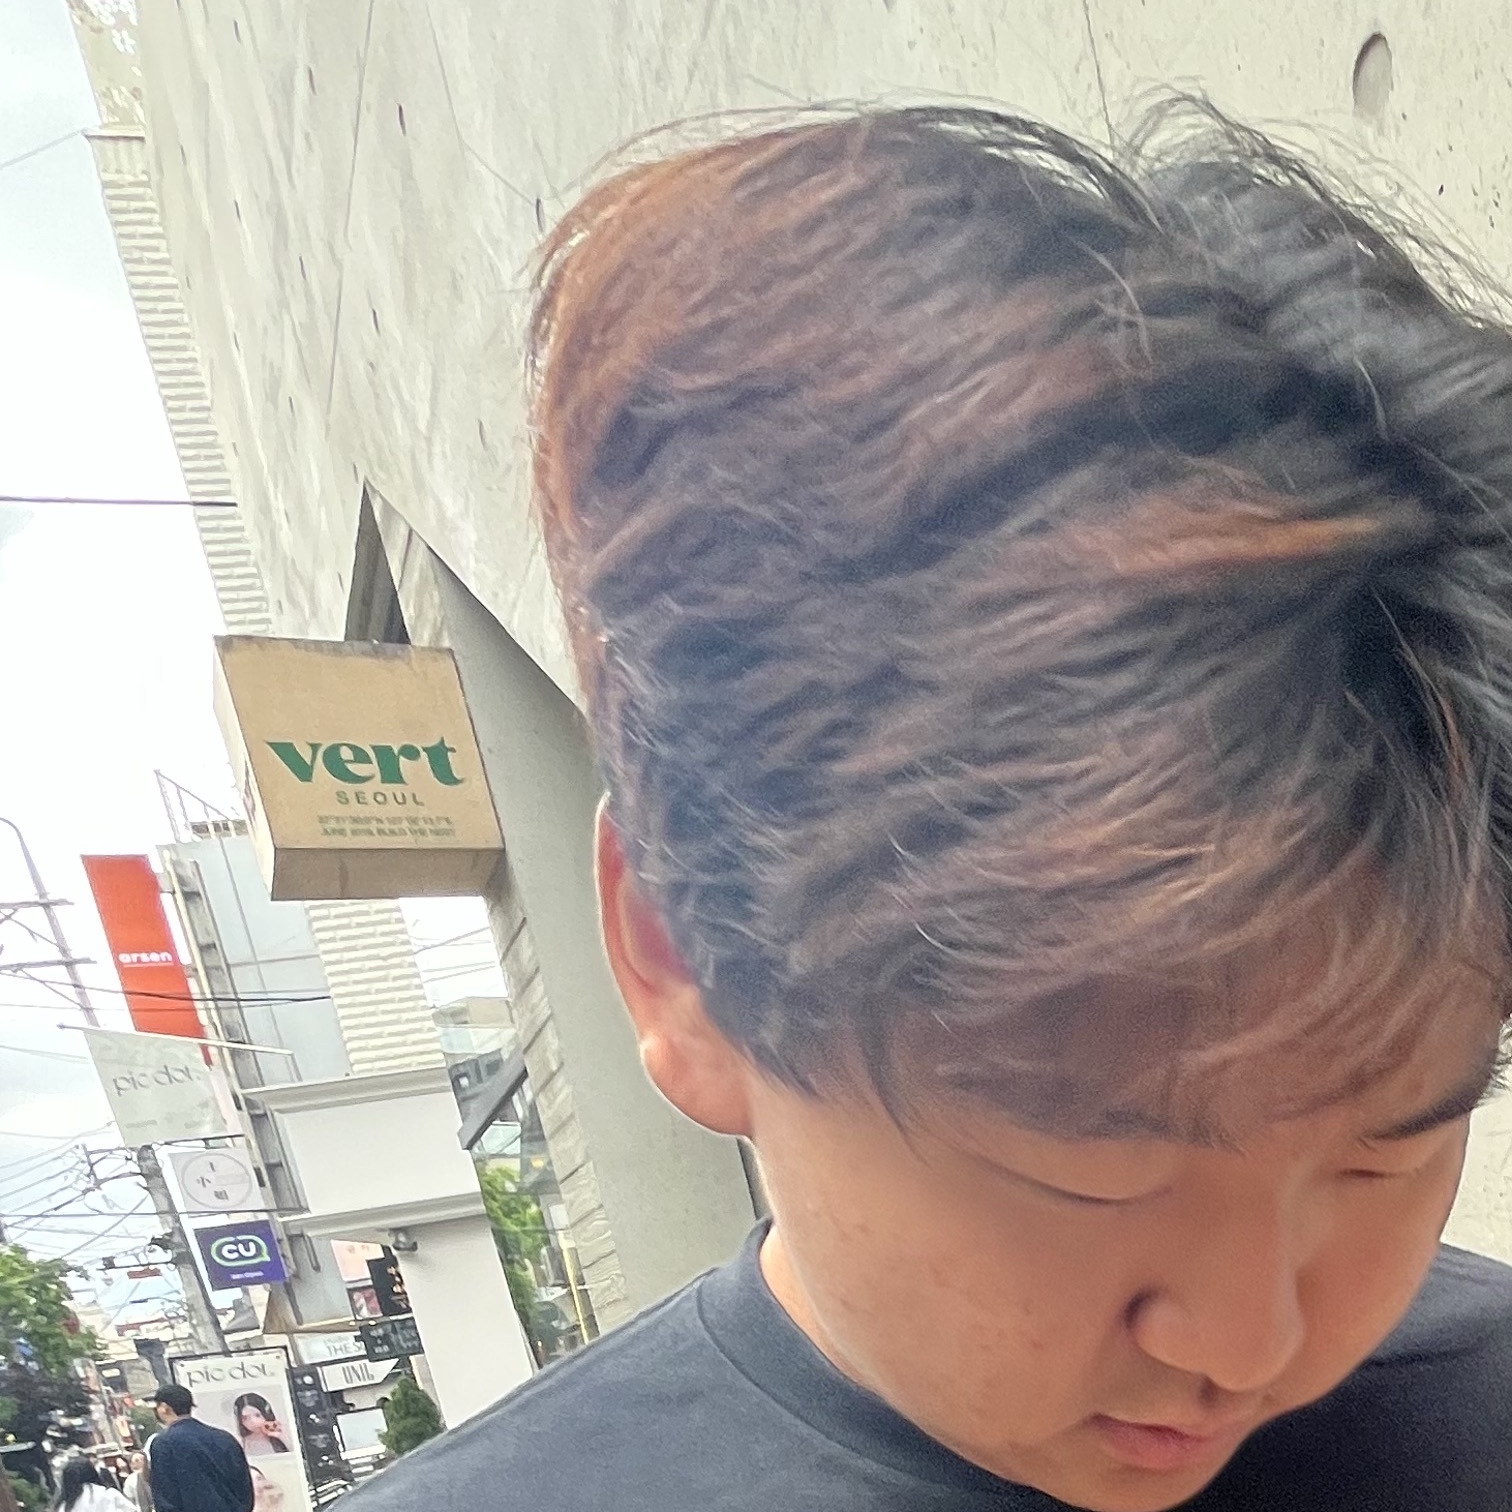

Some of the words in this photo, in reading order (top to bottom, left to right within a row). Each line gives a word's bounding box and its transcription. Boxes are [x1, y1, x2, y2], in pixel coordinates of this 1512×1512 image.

[264, 736, 466, 786] vert
[335, 790, 425, 806] SEOUL
[118, 951, 173, 964] arsen
[221, 1241, 256, 1260] CU
